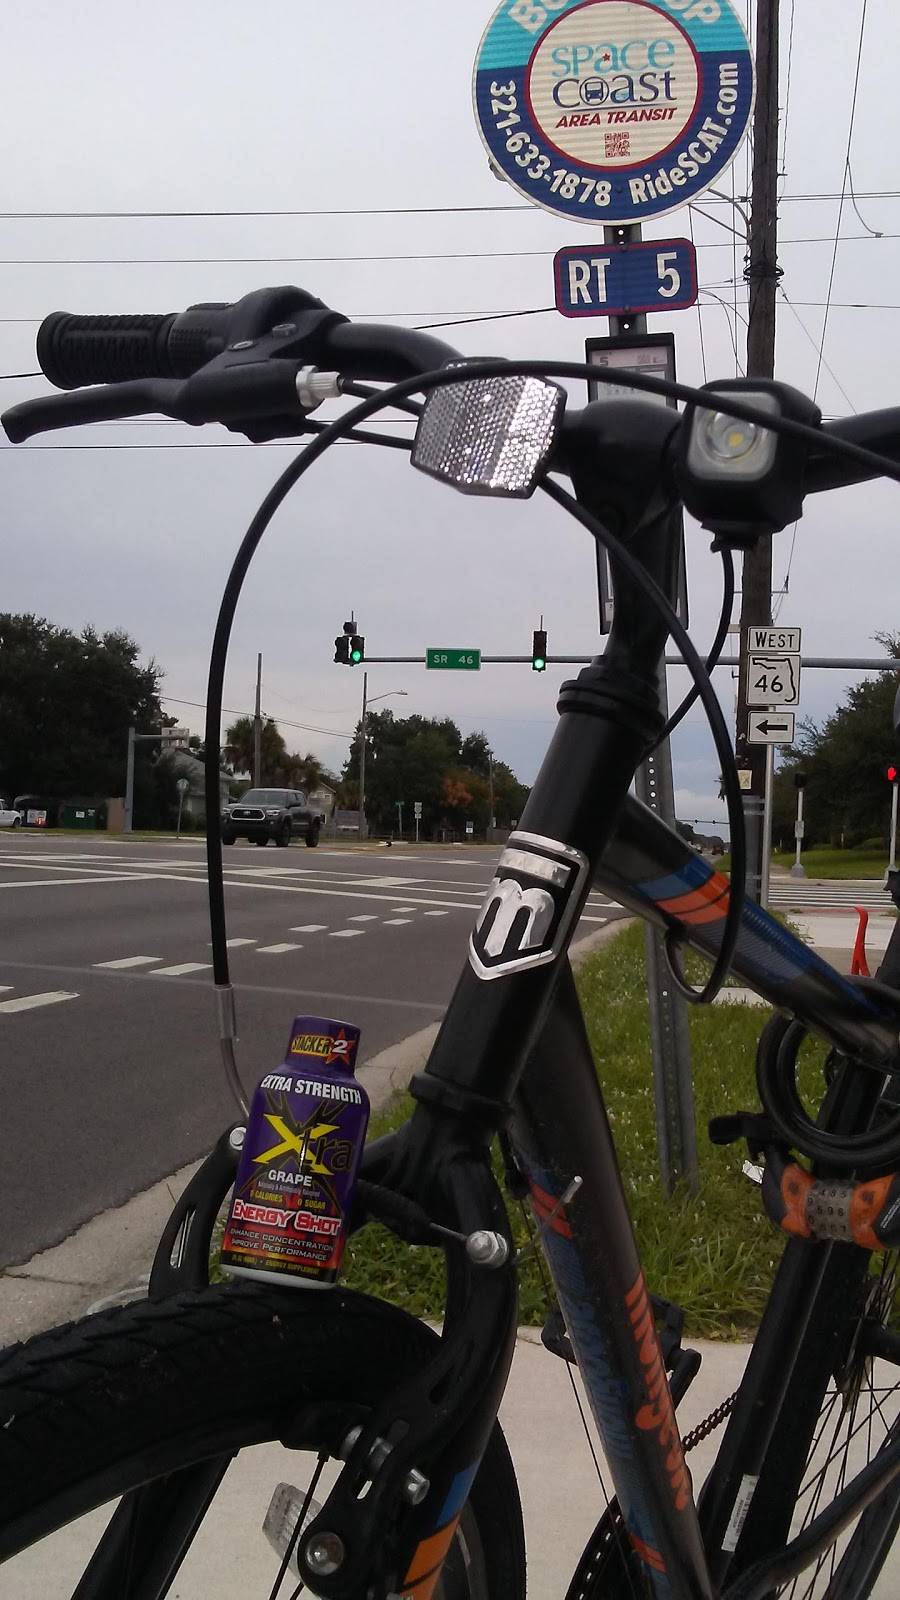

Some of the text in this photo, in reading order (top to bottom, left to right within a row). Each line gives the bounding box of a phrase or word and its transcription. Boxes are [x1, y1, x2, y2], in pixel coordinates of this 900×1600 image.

[555, 107, 678, 129] AREA TRANSIT
[628, 62, 739, 205] RideSCAT.com
[489, 80, 612, 207] 321-633-1878
[568, 252, 681, 305] RT 5
[754, 631, 796, 648] WEST
[433, 654, 473, 665] SR 46
[754, 674, 784, 693] 46
[332, 1039, 349, 1054] 2
[260, 1074, 362, 1105] EXTRA STRENGTH
[268, 1169, 312, 1187] GRAPE
[233, 1199, 341, 1235] ENERGY SHOT
[262, 1234, 334, 1251] CONCENTRATION
[262, 1243, 327, 1261] PERFORMANCE
